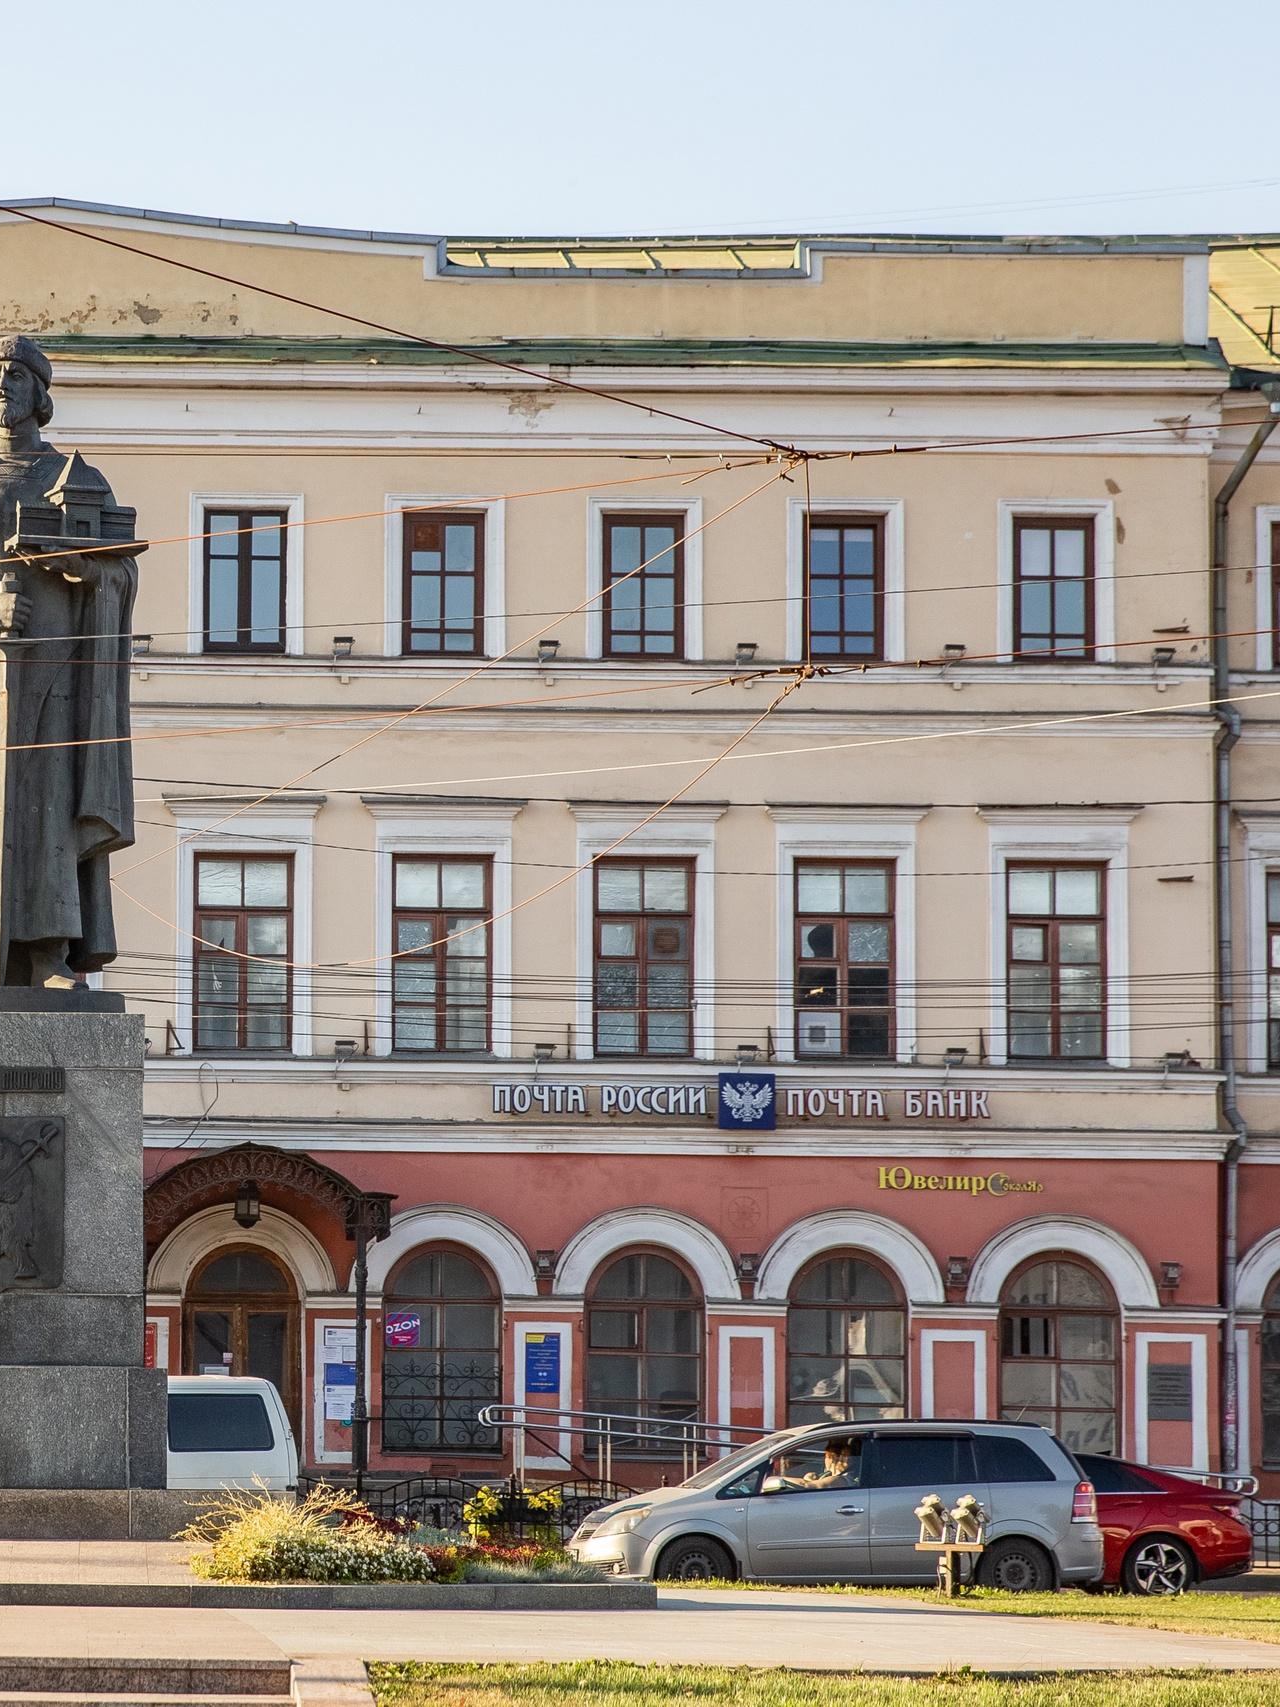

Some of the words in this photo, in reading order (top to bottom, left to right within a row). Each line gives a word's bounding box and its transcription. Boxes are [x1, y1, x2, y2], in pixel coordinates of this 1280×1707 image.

[493, 1084, 586, 1113] ПОЧТА
[601, 1084, 707, 1114] РОССИИ
[786, 1088, 885, 1118] ПОЧТА
[905, 1089, 991, 1119] БАНК
[878, 1166, 986, 1196] Ювелир
[385, 1319, 420, 1334] OZON
